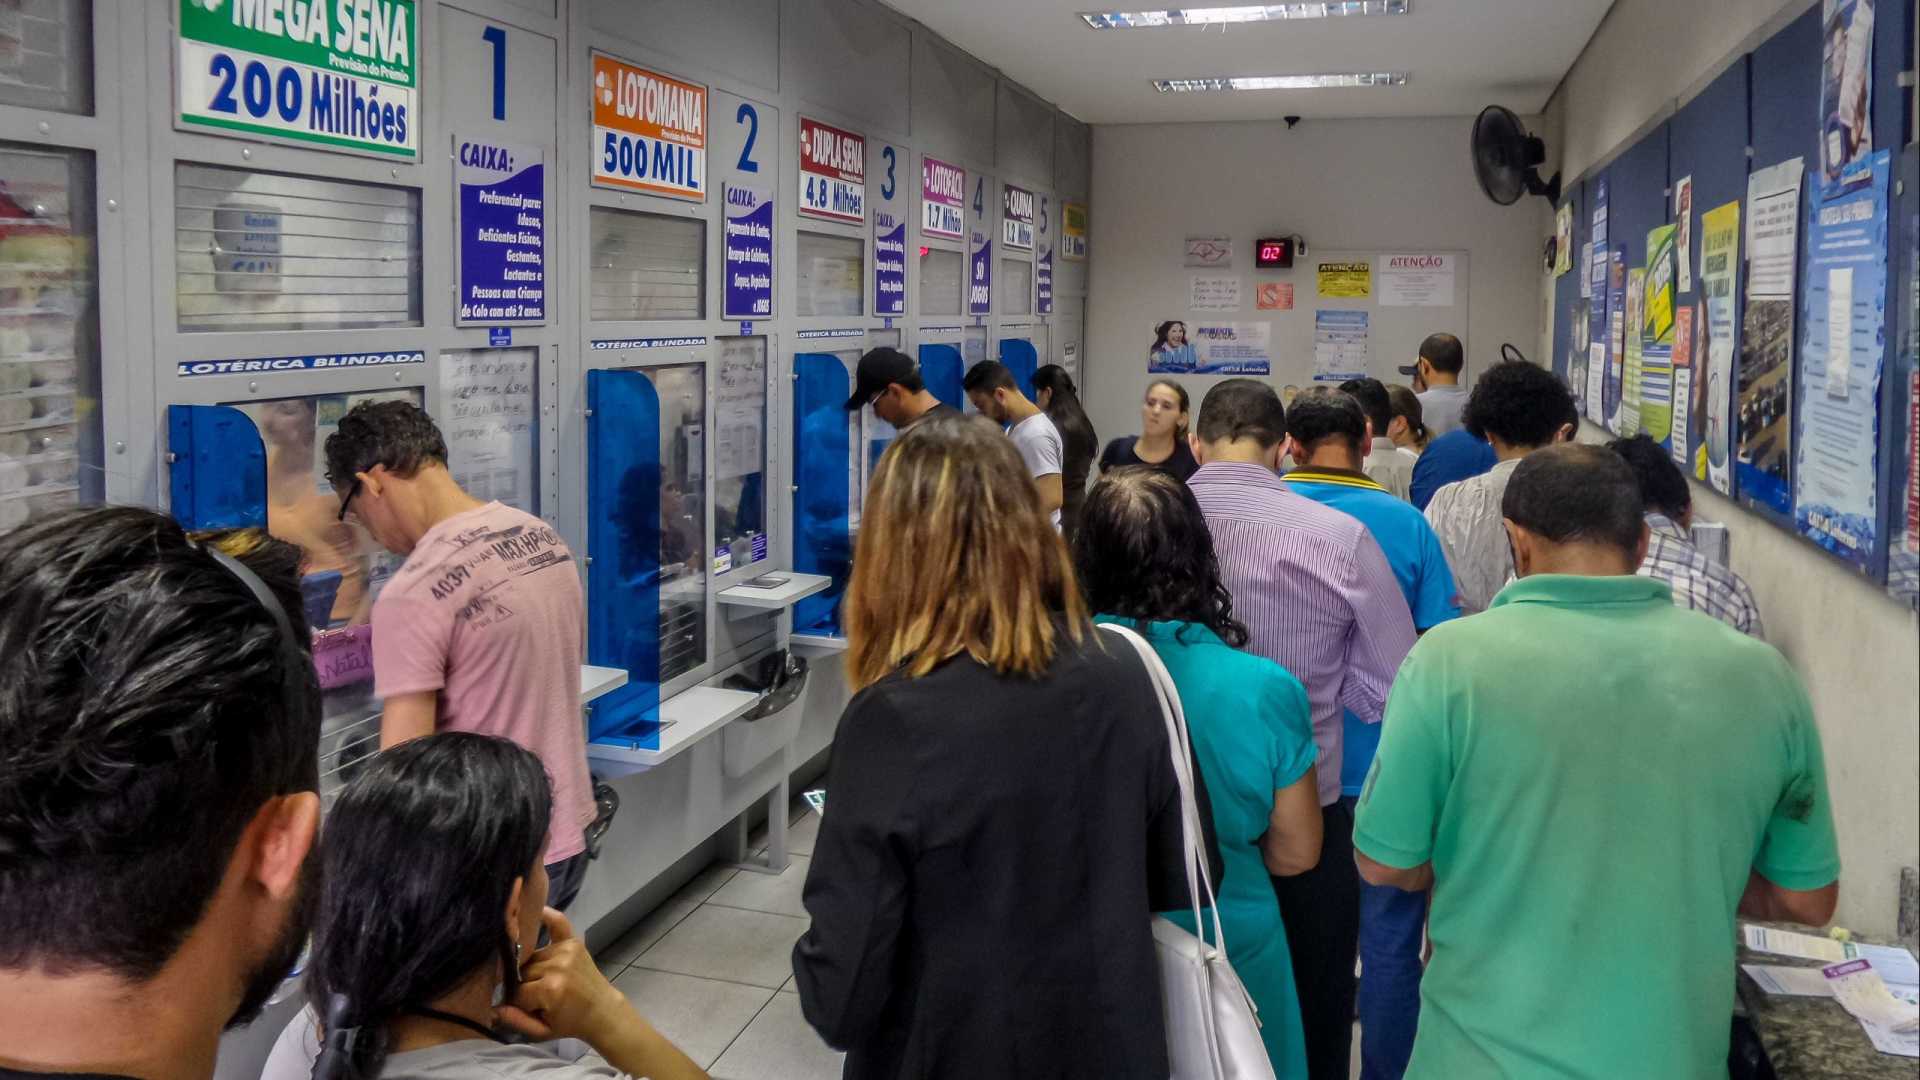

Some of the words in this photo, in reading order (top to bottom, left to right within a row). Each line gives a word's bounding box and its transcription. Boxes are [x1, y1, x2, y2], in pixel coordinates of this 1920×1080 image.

[335, 0, 409, 67] SENA
[329, 52, 368, 73] Previsão
[368, 61, 380, 76] do
[482, 25, 506, 120] 1
[208, 53, 302, 122] 200
[310, 71, 406, 144] Milhões
[617, 68, 702, 135] LOTOMANIA
[736, 102, 758, 173] 2
[460, 142, 514, 172] CAIXA:
[604, 132, 648, 178] 500
[652, 140, 698, 188] MIL
[813, 127, 841, 169] DUPLA
[842, 138, 863, 175] SENA
[881, 145, 896, 200] 3
[479, 190, 523, 209] Preferencial
[522, 198, 541, 210] para:
[728, 187, 756, 208] CAIXA:
[806, 176, 827, 208] 4.8
[973, 176, 983, 220] 4
[1010, 190, 1033, 218] QUINA
[517, 212, 541, 229] Idosos,
[928, 203, 940, 228] 1.7
[1040, 197, 1047, 234] 5
[479, 228, 517, 244] Deficientes
[517, 231, 541, 247] Físicos,
[506, 249, 542, 265] Gestantes,
[1262, 247, 1280, 260] 02
[1390, 256, 1443, 268] ATENÇÃO
[504, 267, 536, 281] Lactantes
[536, 272, 542, 281] e
[976, 257, 985, 280] SÓ
[472, 285, 501, 299] Pessoas
[502, 288, 516, 299] com
[517, 286, 542, 302] Criança
[971, 285, 989, 304] JOGOS
[461, 304, 471, 317] de
[472, 304, 487, 317] Colo
[489, 306, 503, 317] com
[505, 305, 516, 317] até
[518, 304, 523, 316] 2
[524, 307, 542, 317] anos.
[651, 338, 706, 348] BLINDADA
[178, 359, 305, 376] LOTÉRICA
[313, 353, 425, 368] BLINDADA
